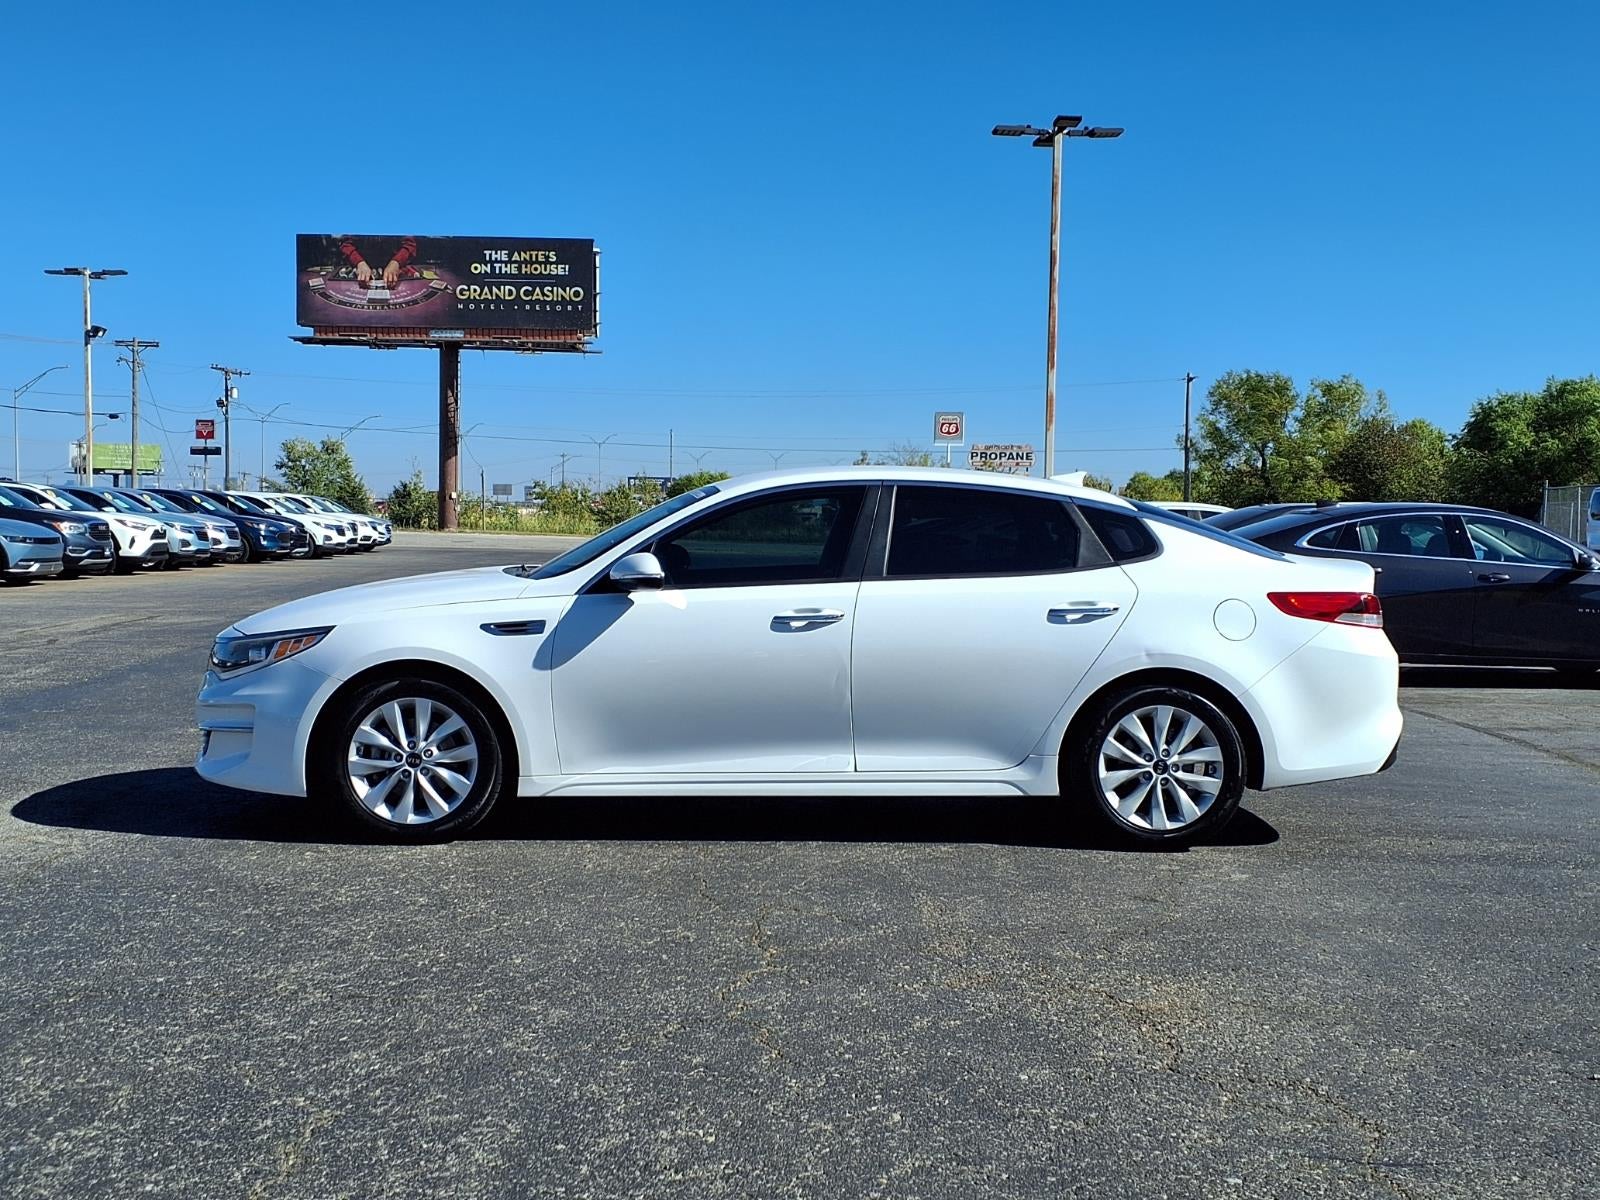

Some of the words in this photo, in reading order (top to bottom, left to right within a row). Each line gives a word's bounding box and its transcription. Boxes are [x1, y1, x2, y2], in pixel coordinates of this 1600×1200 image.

[484, 250, 508, 261] THE
[511, 251, 557, 262] ANTE'S
[470, 263, 491, 274] ON
[494, 263, 518, 274] THE
[521, 264, 569, 275] HOUSE!
[456, 284, 517, 300] GRAND
[520, 286, 584, 301] CASINO
[942, 423, 957, 433] 66
[970, 451, 1033, 461] PROPANE
